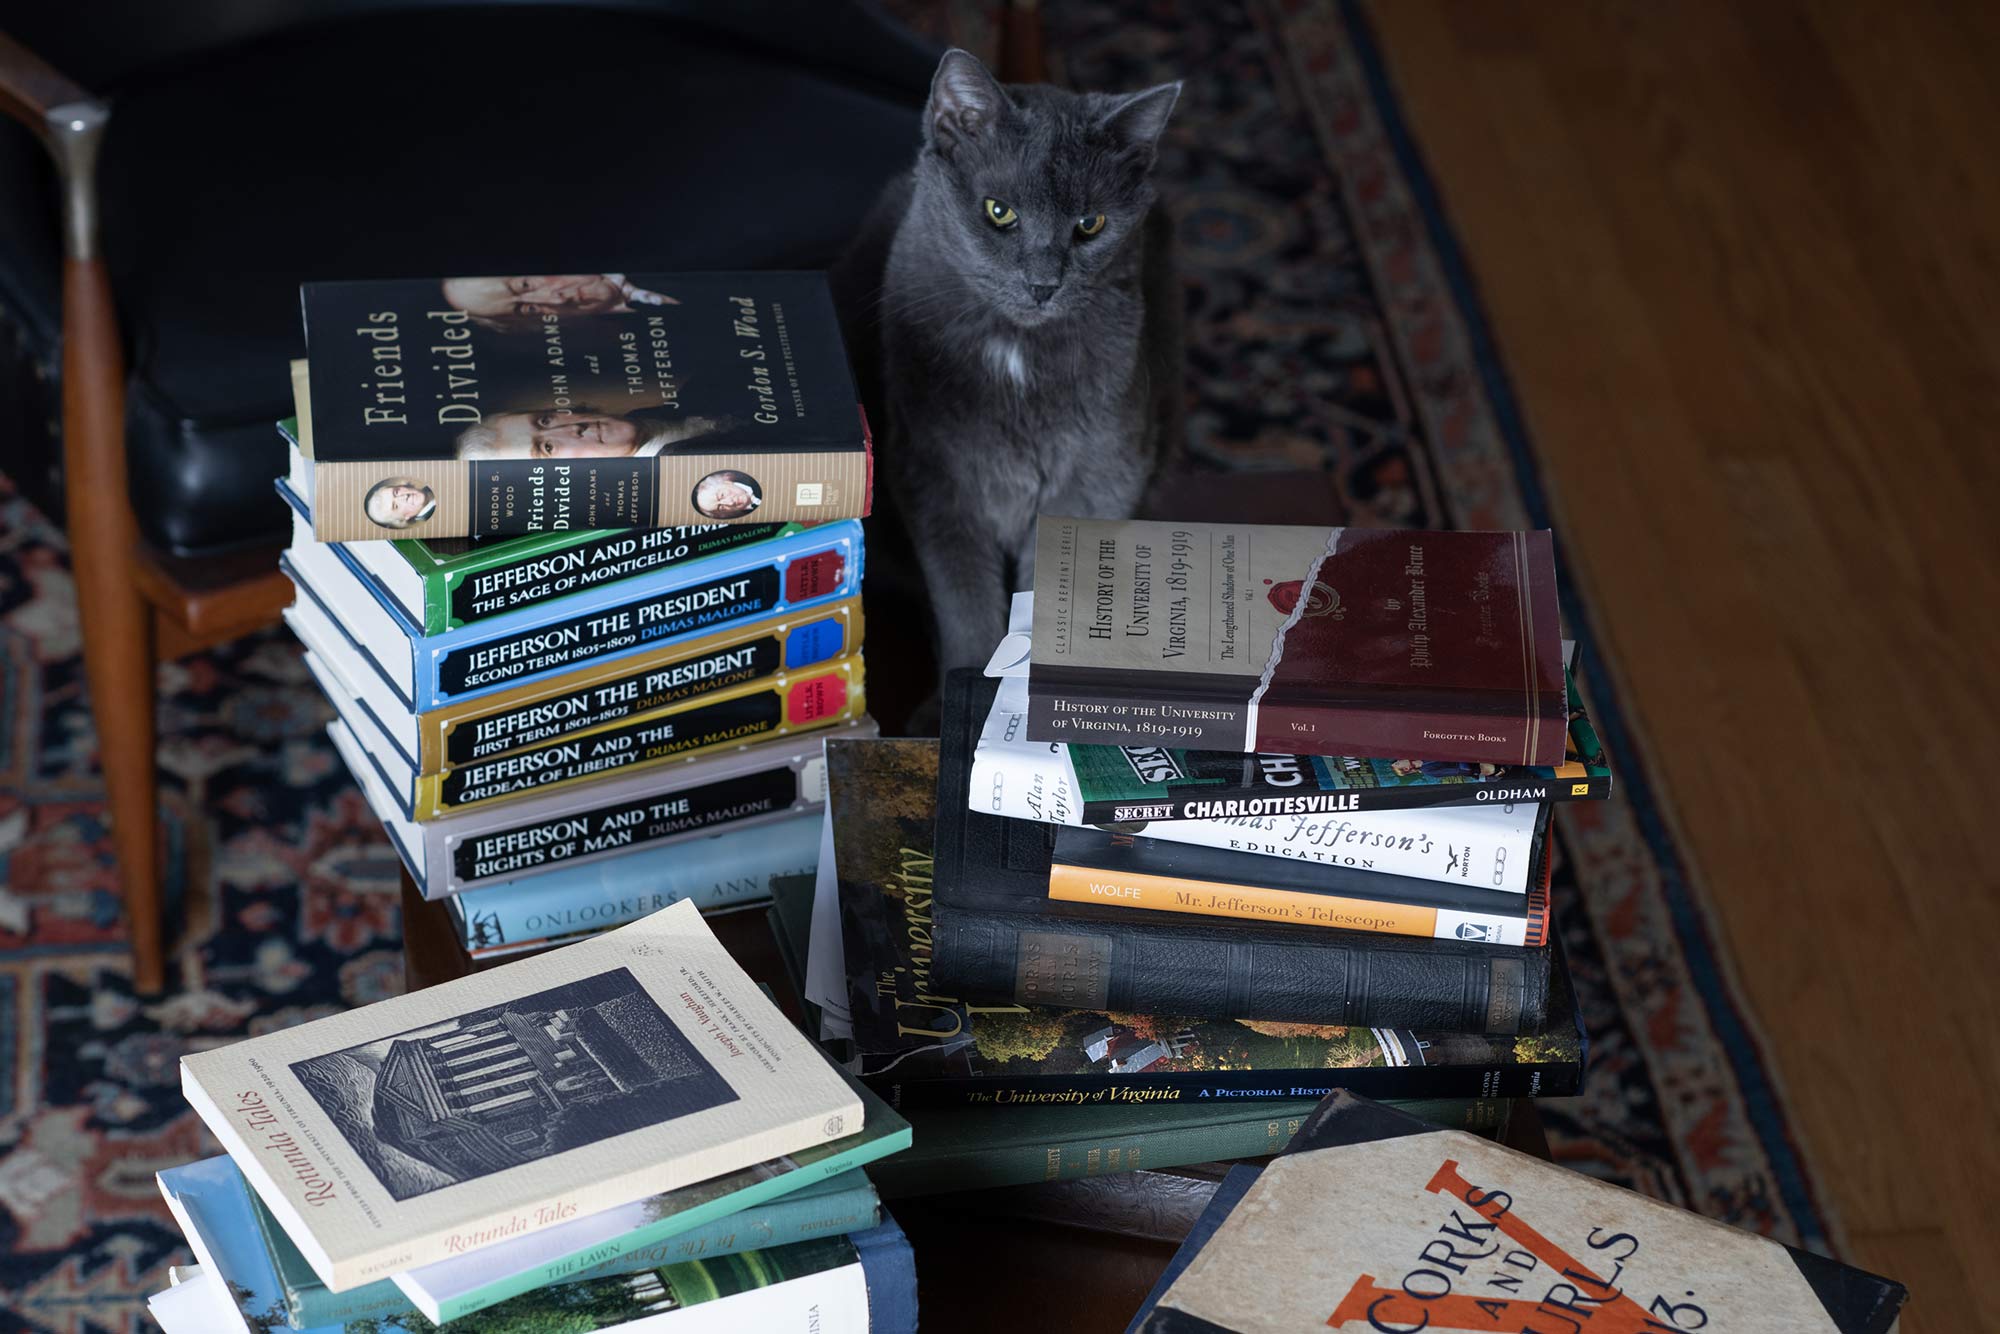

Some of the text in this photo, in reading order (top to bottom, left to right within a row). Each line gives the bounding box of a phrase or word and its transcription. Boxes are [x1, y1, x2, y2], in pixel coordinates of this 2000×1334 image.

[357, 311, 407, 425] Friends
[427, 310, 481, 424] Divided
[542, 314, 573, 416] JOHN ADAMS
[584, 354, 600, 375] and
[619, 332, 643, 394] THOMAS
[649, 316, 679, 409] JEFFERSON
[729, 296, 778, 424] Gordon S. Wood
[491, 486, 500, 530] GORDON
[506, 486, 515, 517] WOOD
[528, 466, 545, 531] Friends
[553, 465, 571, 530] Divided
[589, 469, 597, 527] JOHN ADAMS
[617, 480, 625, 517] THOMAS
[631, 471, 639, 524] JEFFERSON
[698, 525, 773, 551] DUMAS MALONE
[472, 545, 688, 614] THE SAGE OF MONTICELLO
[473, 528, 673, 599] JEFFERSON AND HIS
[1056, 525, 1072, 654] CLASSIC REPRINT SERIES
[1089, 539, 1116, 640] HISTORY OF THE
[1126, 544, 1151, 637] UNIVERSITY OF
[1163, 531, 1193, 658] VIRGINIA, 1819-1919
[1221, 535, 1238, 660] The Lengthened Shadow of One Man
[1384, 599, 1400, 611] by
[1405, 544, 1432, 668] Philip Alexander Bruce
[468, 580, 750, 673] JEFFERSON THE PRESIDENT
[641, 598, 762, 640] DUMAS MALONE
[464, 634, 636, 688] SECOND TERM 1805-1809
[475, 647, 756, 744] JEFFERSON THE PRESIDENT
[636, 669, 755, 711] DUMAS MALONE
[1054, 700, 1236, 721] HISTORY OF THE UNIVERSITY
[472, 706, 629, 757] FIRST TERM 1801-1805
[646, 721, 768, 758] DUMAS MALONE
[1052, 717, 1202, 737] OF VIRGINIA, 1819-1919
[1290, 722, 1309, 732] Vol.
[1423, 730, 1507, 743] FORGOTTEN BOOKS
[459, 751, 639, 803] ORDEAL OF LIBERTY
[464, 725, 674, 788] JEFFERSON AND THE
[1026, 773, 1044, 820] Alan
[1049, 777, 1071, 824] Taylor
[1115, 794, 1360, 820] SECRET CHARLOTTESVILLE
[1476, 787, 1546, 801] OLDHAM
[474, 800, 690, 861] JEFFERSON AND THE
[649, 799, 772, 837] DUMAS MALONE
[1284, 814, 1434, 854] Jefferson's
[474, 830, 632, 878] RIGHTS OF MAN
[1229, 839, 1375, 868] EDUCATION
[1461, 846, 1471, 877] NORTON
[526, 876, 759, 931] ONLOOKERS ANN
[1089, 882, 1395, 929] WOLFE Mr. Jefferson's Telescope
[697, 970, 716, 990] SMITH
[875, 971, 896, 997] The
[1025, 943, 1041, 1000] CORKS
[1063, 943, 1080, 1000] CURLS
[680, 992, 743, 1057] Joseph L. Vaughan
[720, 1014, 739, 1033] FRANK
[721, 997, 745, 1023] CHARLES
[744, 1022, 753, 1031] BY
[738, 1034, 747, 1042] BY
[746, 1042, 776, 1073] FOREWORD
[752, 1030, 781, 1061] WOODCUTS
[248, 1056, 276, 1090] 1920-1960
[967, 1085, 1285, 1105] The University of Virginia A PICTORIAL
[237, 1090, 336, 1207] Rotunda Tales
[303, 1127, 335, 1167] UNIVERSITY
[361, 1201, 577, 1275] VAUGHAN Rotunda Tales
[546, 1261, 574, 1279] THE
[580, 1243, 621, 1266] LAWN
[1367, 1186, 1513, 1334] CORKS
[1475, 1250, 1539, 1321] AND
